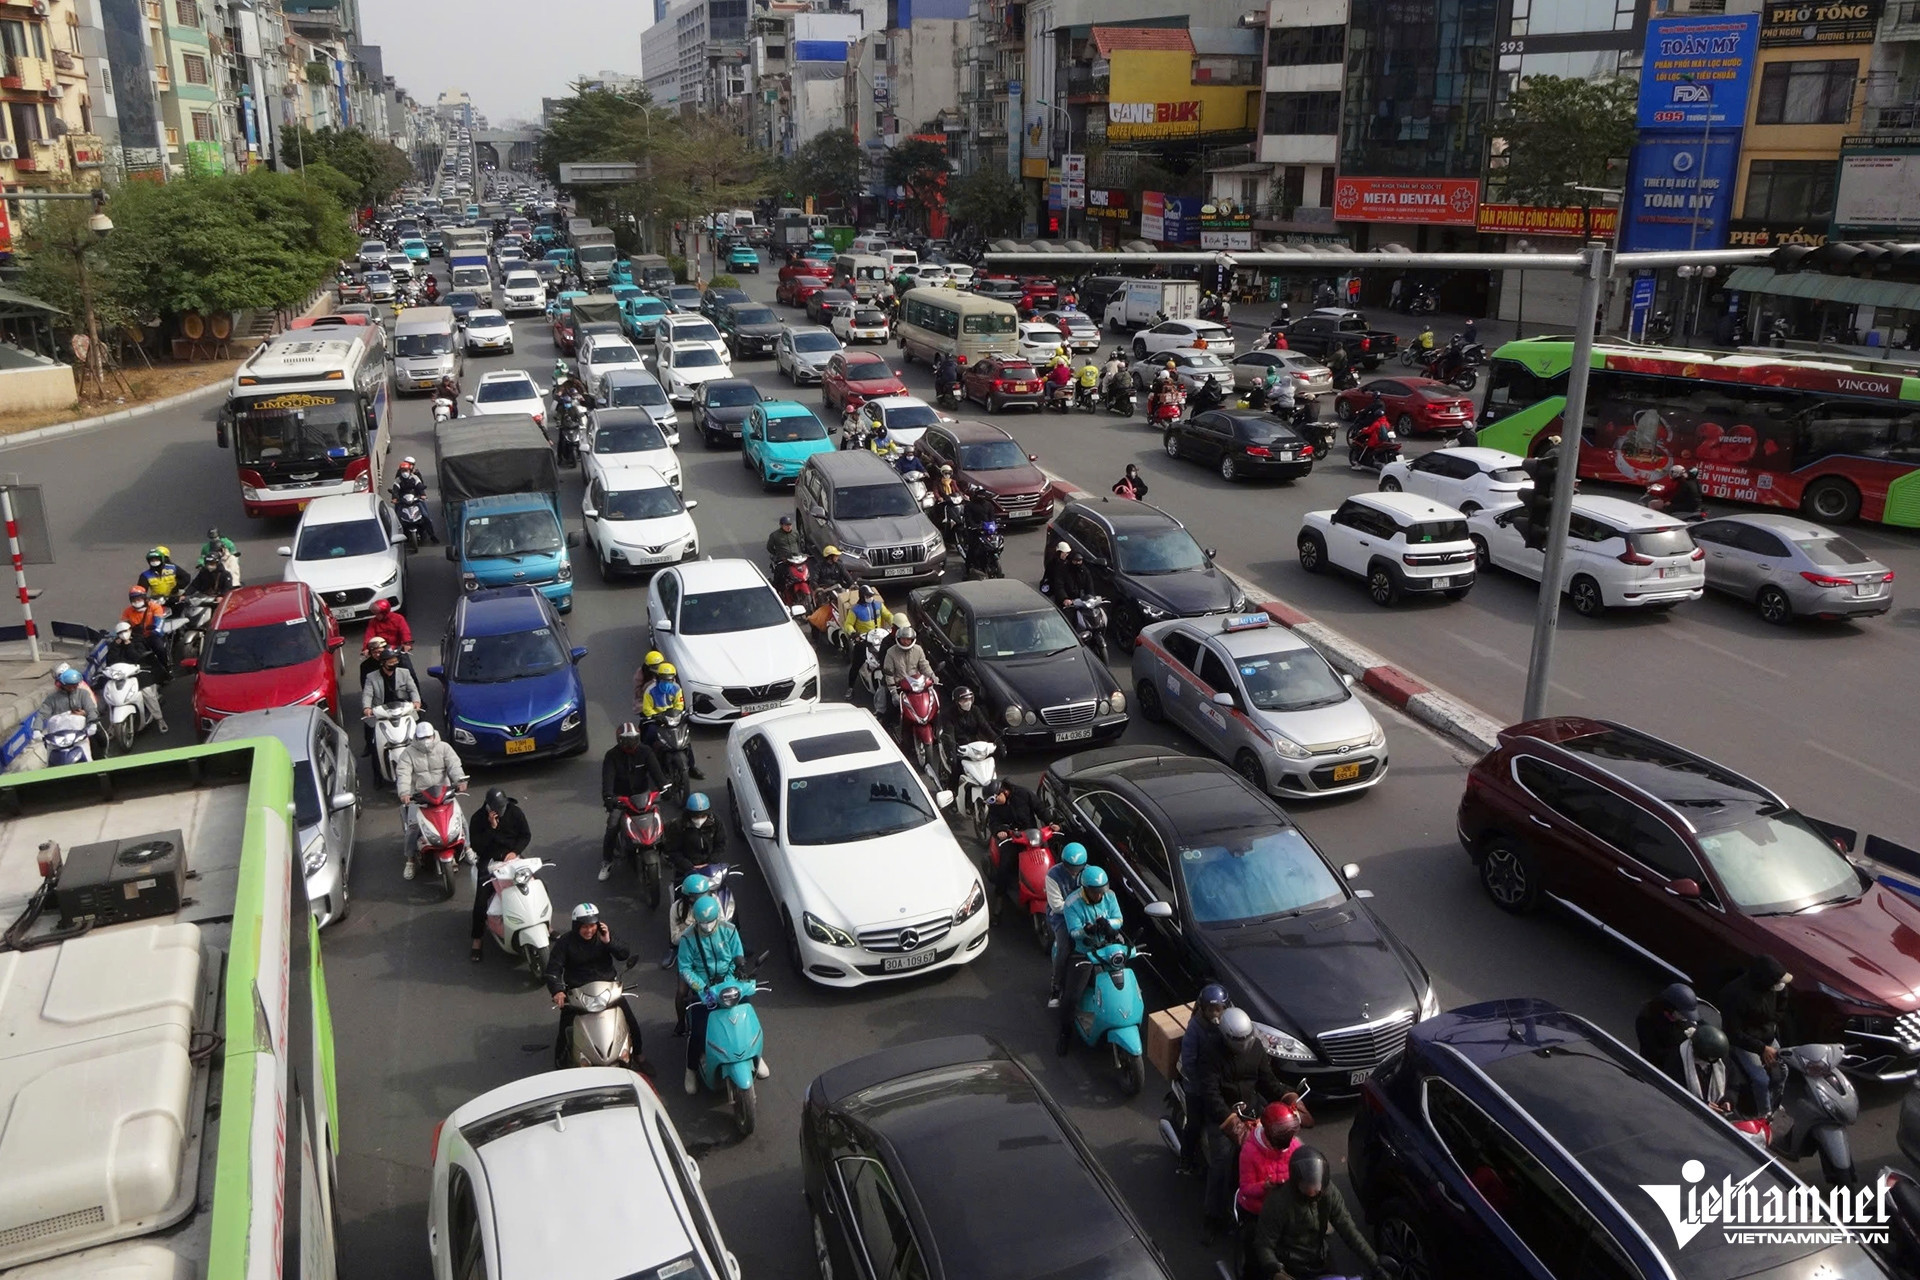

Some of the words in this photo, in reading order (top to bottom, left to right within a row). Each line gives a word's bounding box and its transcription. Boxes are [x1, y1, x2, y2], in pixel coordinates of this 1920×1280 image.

[1772, 4, 1813, 23] PHỞ
[1500, 41, 1524, 53] 393
[1661, 34, 1709, 55] TOÀN
[1711, 32, 1739, 54] MỸ
[1673, 85, 1711, 102] FDA
[1156, 101, 1200, 123] BUK
[1654, 111, 1684, 122] 395
[1363, 192, 1396, 204] META
[1399, 193, 1448, 206] DENTAL
[1643, 191, 1685, 209] TOÀN
[1480, 206, 1495, 224] VĂN
[1496, 207, 1525, 226] PHÒNG
[1525, 208, 1548, 227] CÔNG
[1729, 228, 1770, 246] PHỞ
[1837, 378, 1889, 394] VINCOM
[253, 396, 337, 411] LIMOUSINE
[1718, 434, 1752, 446] VINCOM
[1712, 473, 1750, 487] VINCOM
